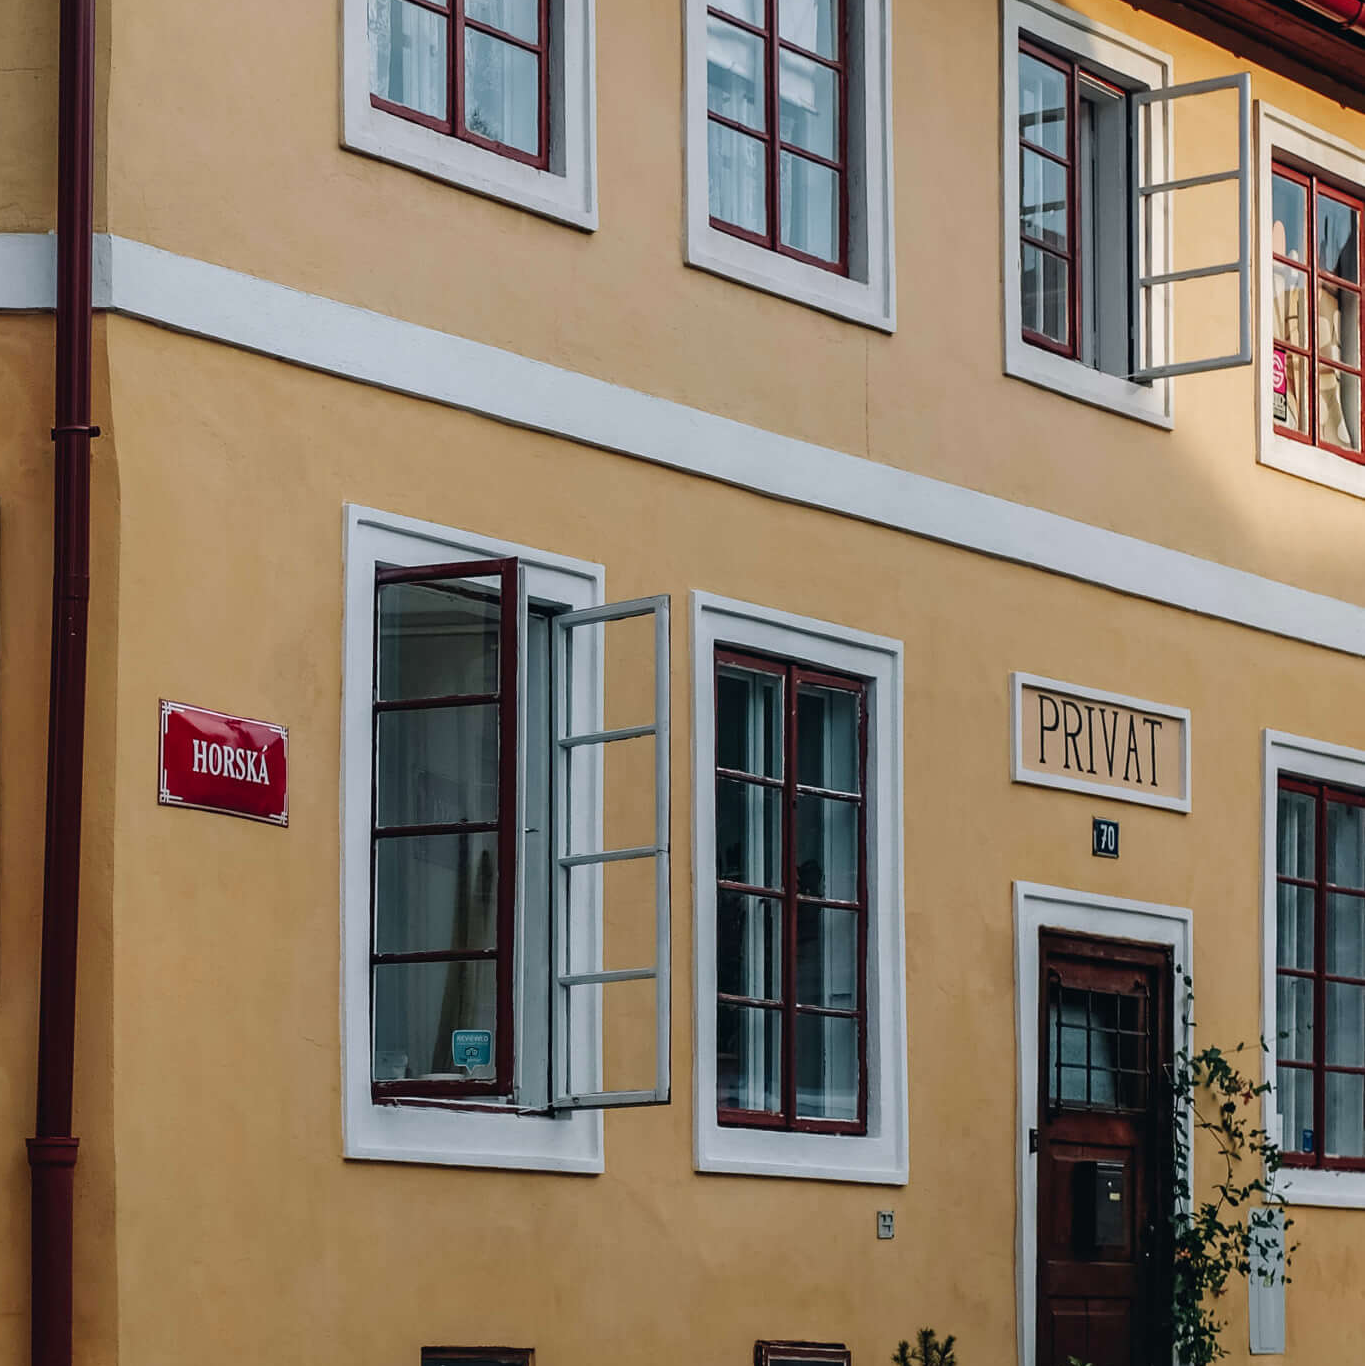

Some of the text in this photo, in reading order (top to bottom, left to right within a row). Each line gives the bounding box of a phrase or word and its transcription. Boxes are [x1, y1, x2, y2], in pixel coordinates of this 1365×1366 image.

[192, 738, 270, 785] HORSKÁ
[1037, 693, 1163, 787] PRIVAT
[1100, 823, 1115, 851] 70
